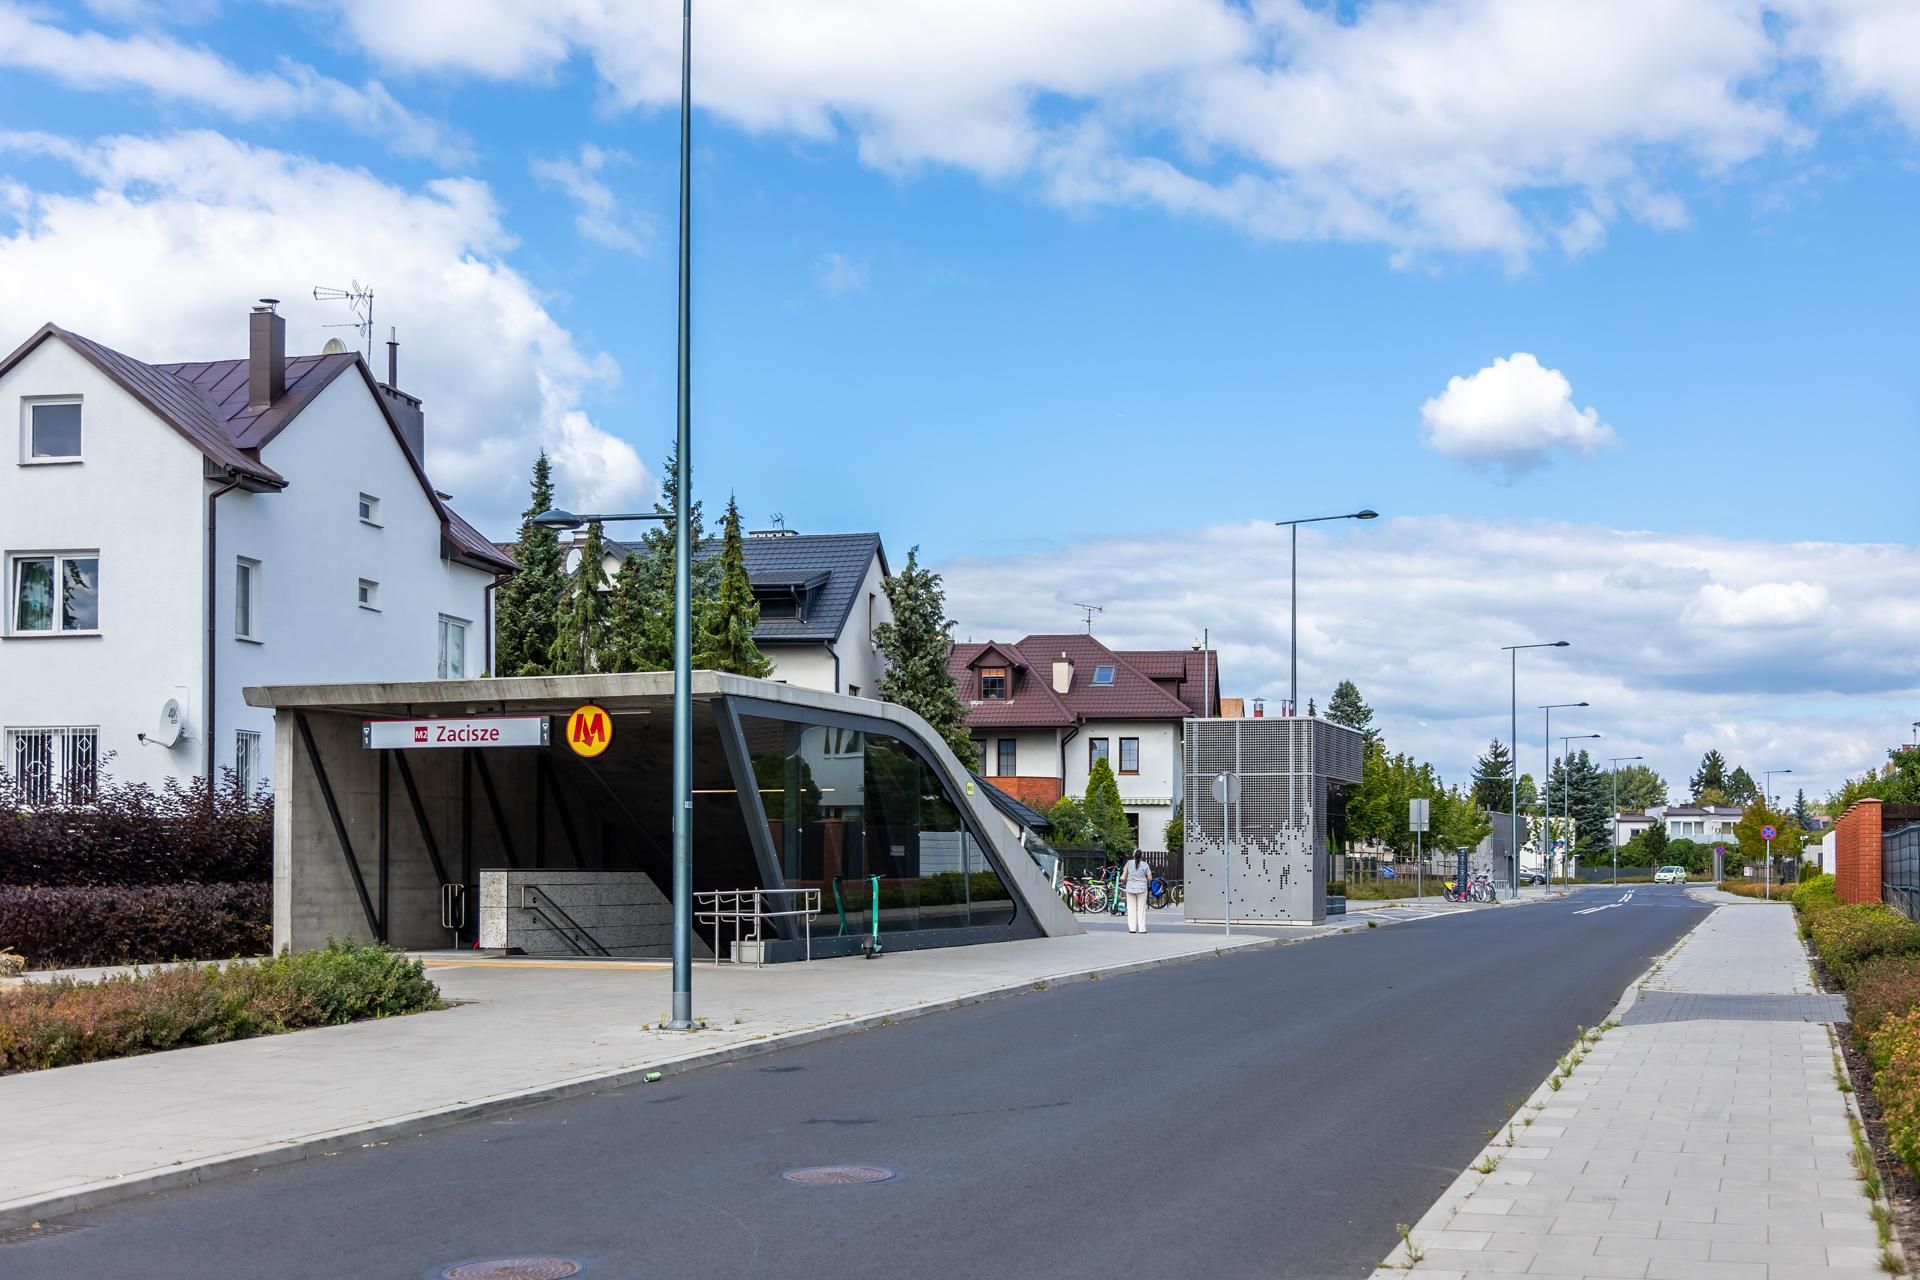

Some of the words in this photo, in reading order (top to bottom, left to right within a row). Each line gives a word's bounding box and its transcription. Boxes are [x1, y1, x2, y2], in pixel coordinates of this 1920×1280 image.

[168, 707, 178, 719] 4K
[415, 730, 428, 739] M2
[436, 724, 500, 742] Zacisze
[573, 713, 606, 747] M
